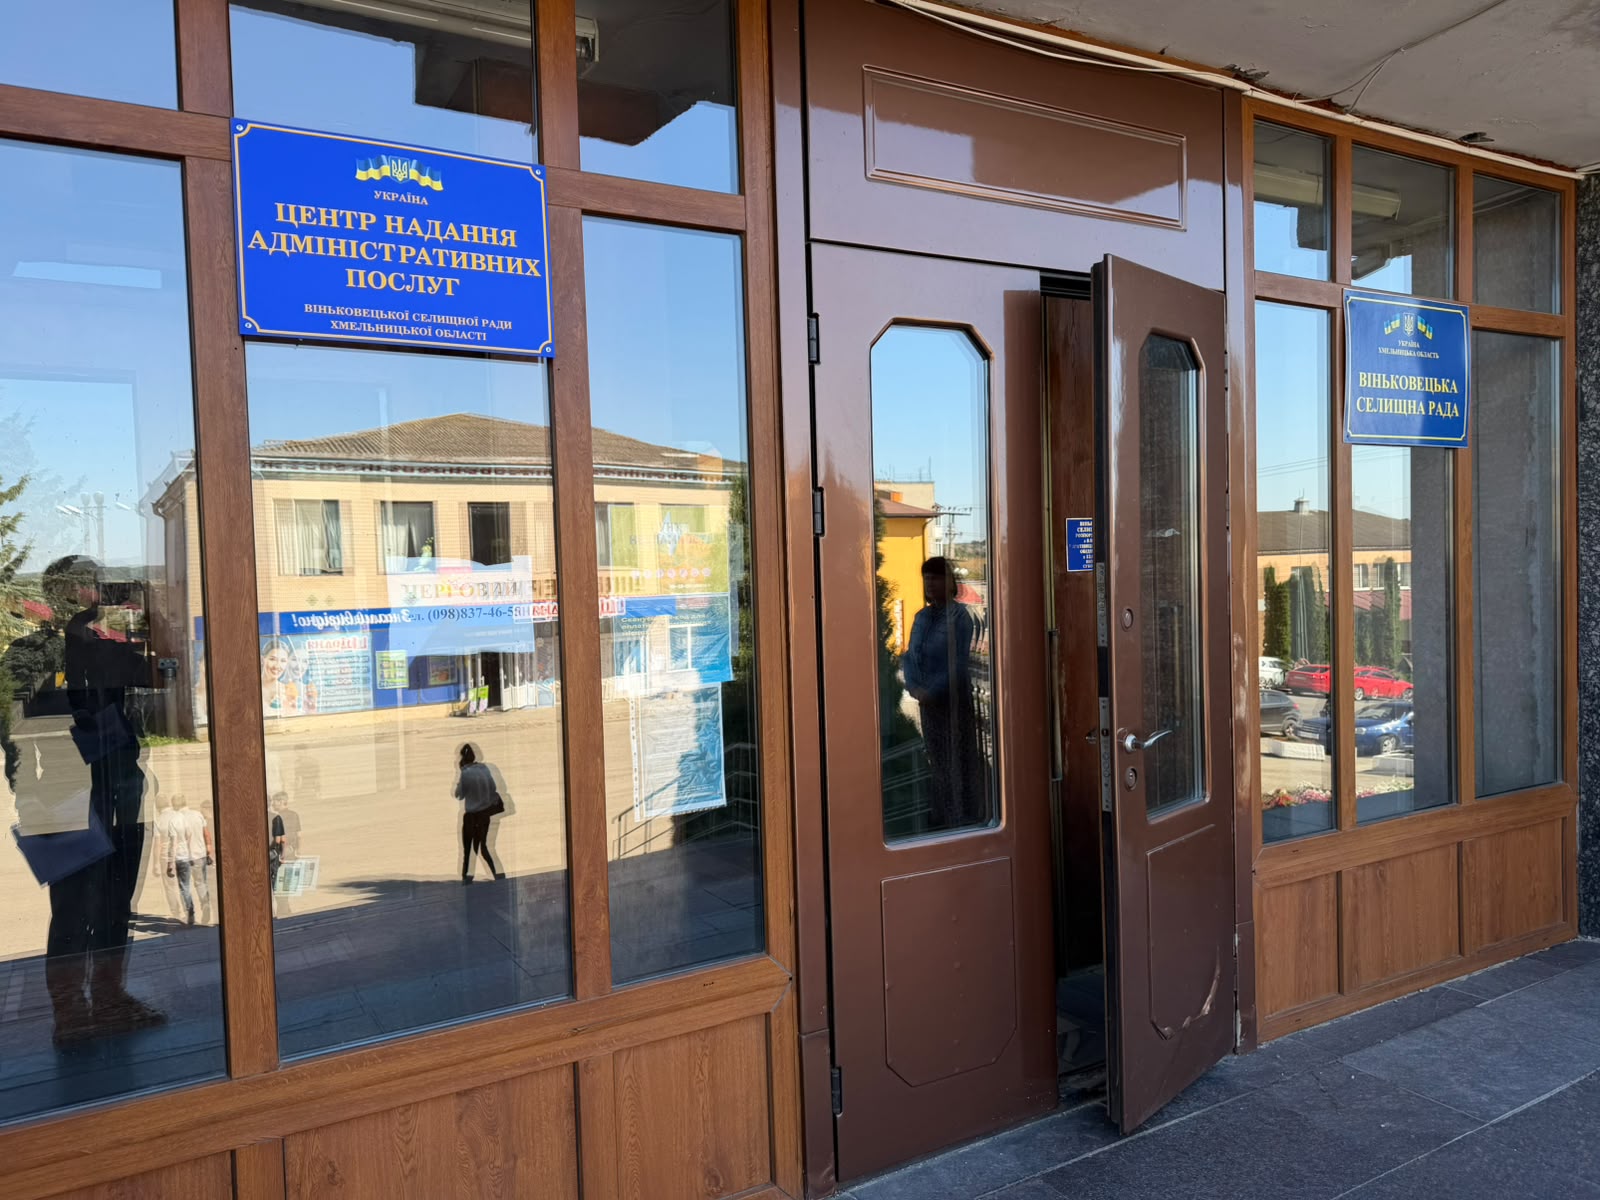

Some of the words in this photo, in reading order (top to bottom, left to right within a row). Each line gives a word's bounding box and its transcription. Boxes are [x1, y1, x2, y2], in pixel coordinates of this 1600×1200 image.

[374, 190, 429, 206] УКРАЇНА
[274, 202, 377, 232] ЦЕНТР
[384, 214, 518, 248] НАДАННЯ
[248, 230, 542, 277] АДМІНІСТРАТИВНИХ
[346, 268, 460, 297] ПОСЛУГ
[304, 303, 410, 322] ВІНЬКОВЕЦЬКОЇ
[412, 312, 480, 328] СЕЛИЩНОЇ
[482, 318, 513, 331] РАДИ
[330, 319, 433, 338] ХМЕЛЬНИЦЬКОЇ
[435, 328, 488, 342] ОБЛАСТІ
[1378, 346, 1416, 357] ХМЕЛЬНИЦЬКА
[1416, 350, 1440, 360] ОБЛАСТЬ
[1398, 340, 1420, 348] УКРАЇНА
[1358, 371, 1459, 394] ВІНЬКОВЕЦЬКА
[1356, 396, 1426, 417] СЕЛИЩНА
[1428, 401, 1460, 419] РАДА
